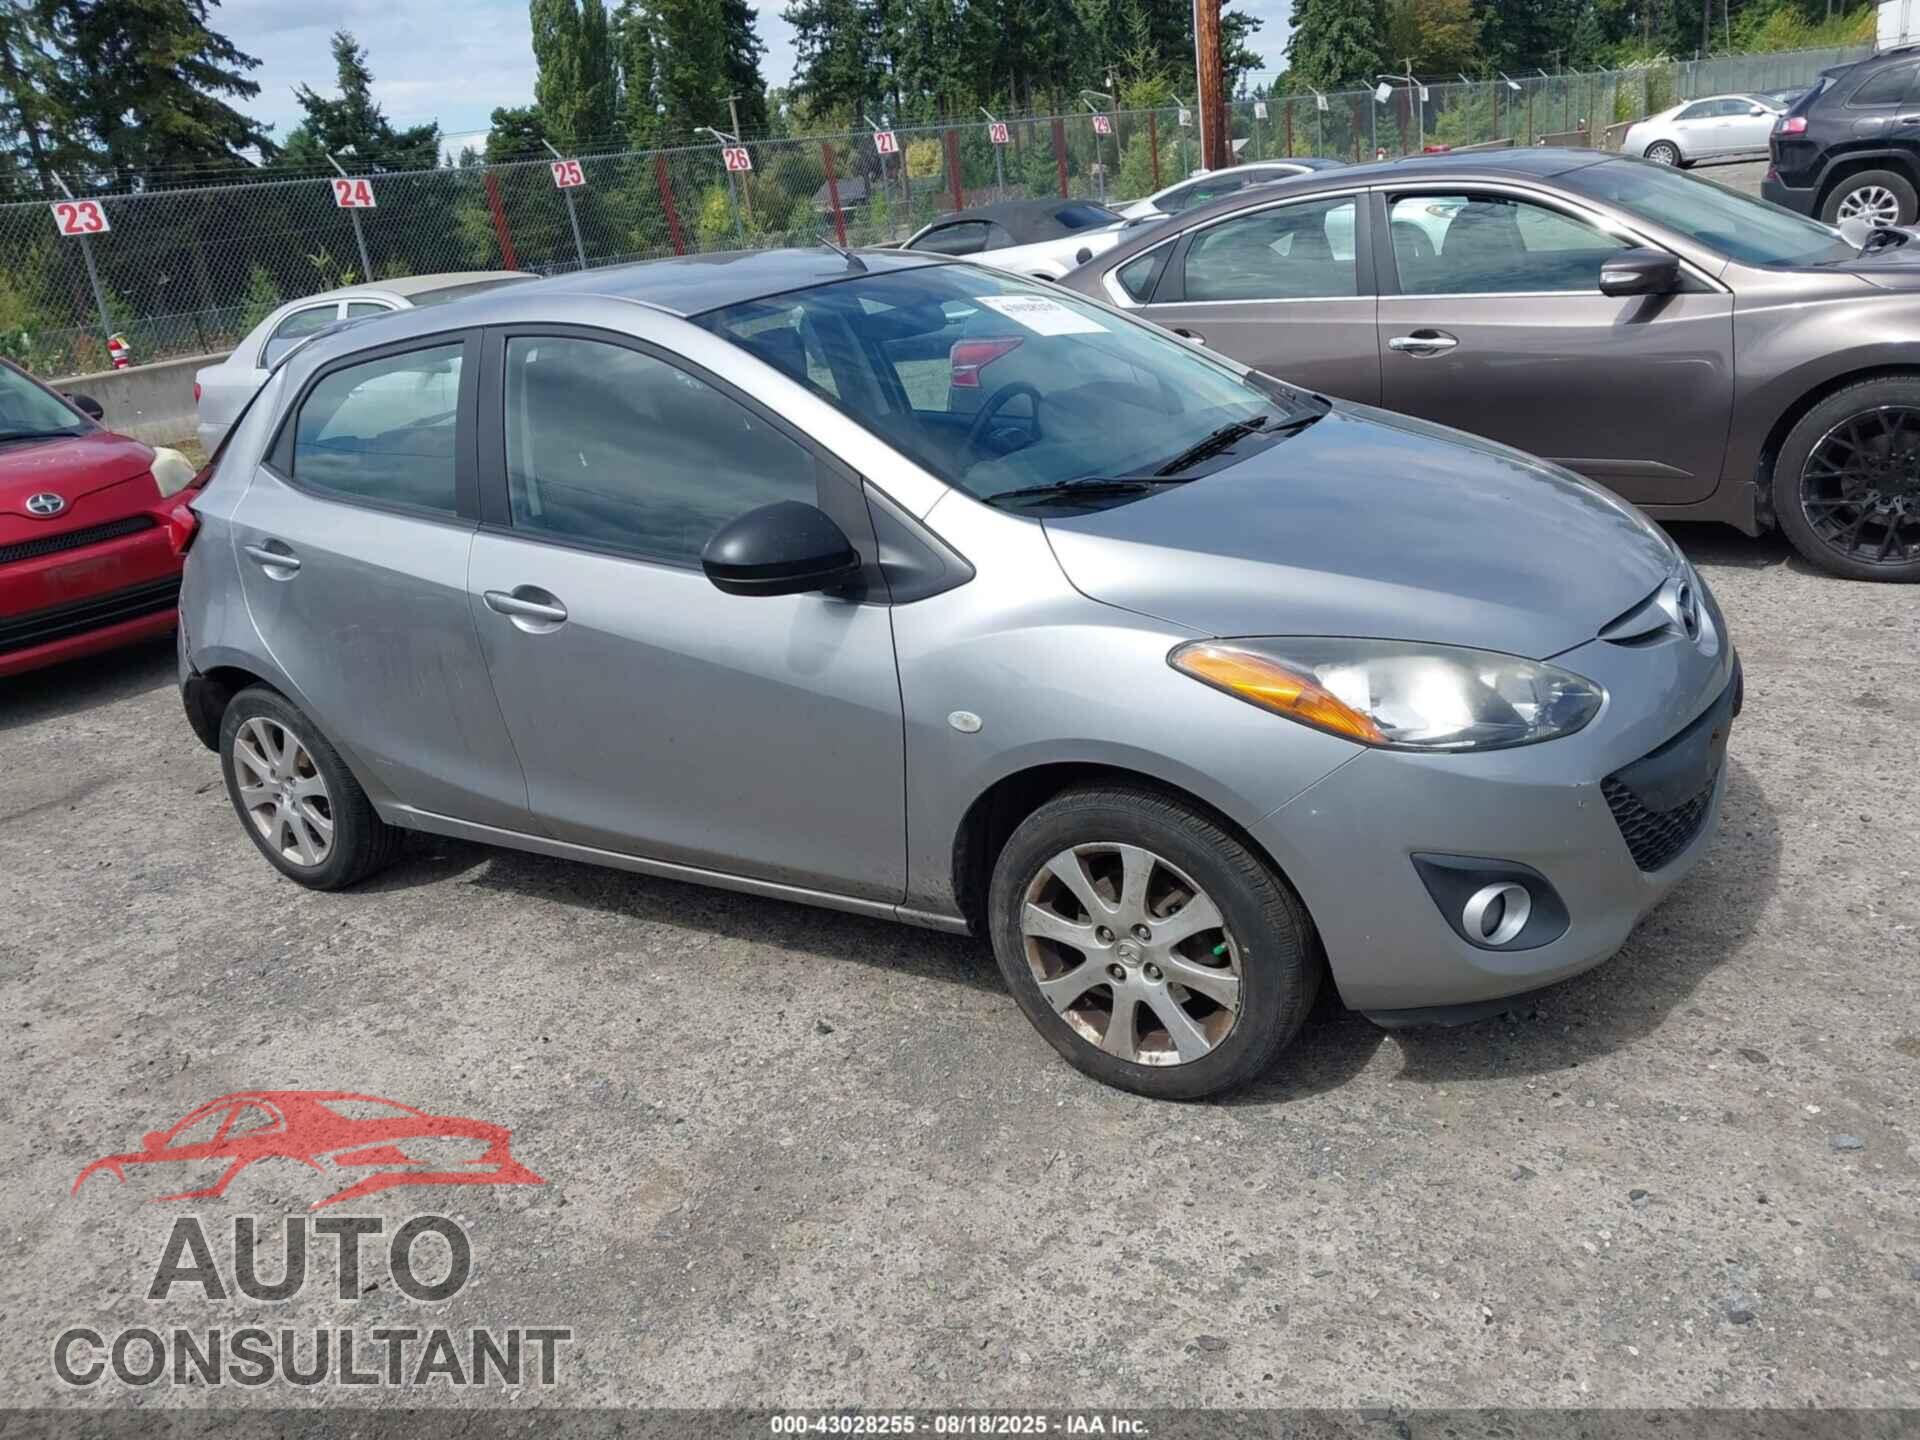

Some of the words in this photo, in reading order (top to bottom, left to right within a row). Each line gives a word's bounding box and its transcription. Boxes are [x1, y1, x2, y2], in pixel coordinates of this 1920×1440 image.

[877, 134, 893, 152] 27
[992, 125, 1007, 142] 28
[726, 150, 748, 169] 26
[555, 162, 581, 186] 25
[337, 180, 370, 206] 24
[57, 202, 103, 233] 23
